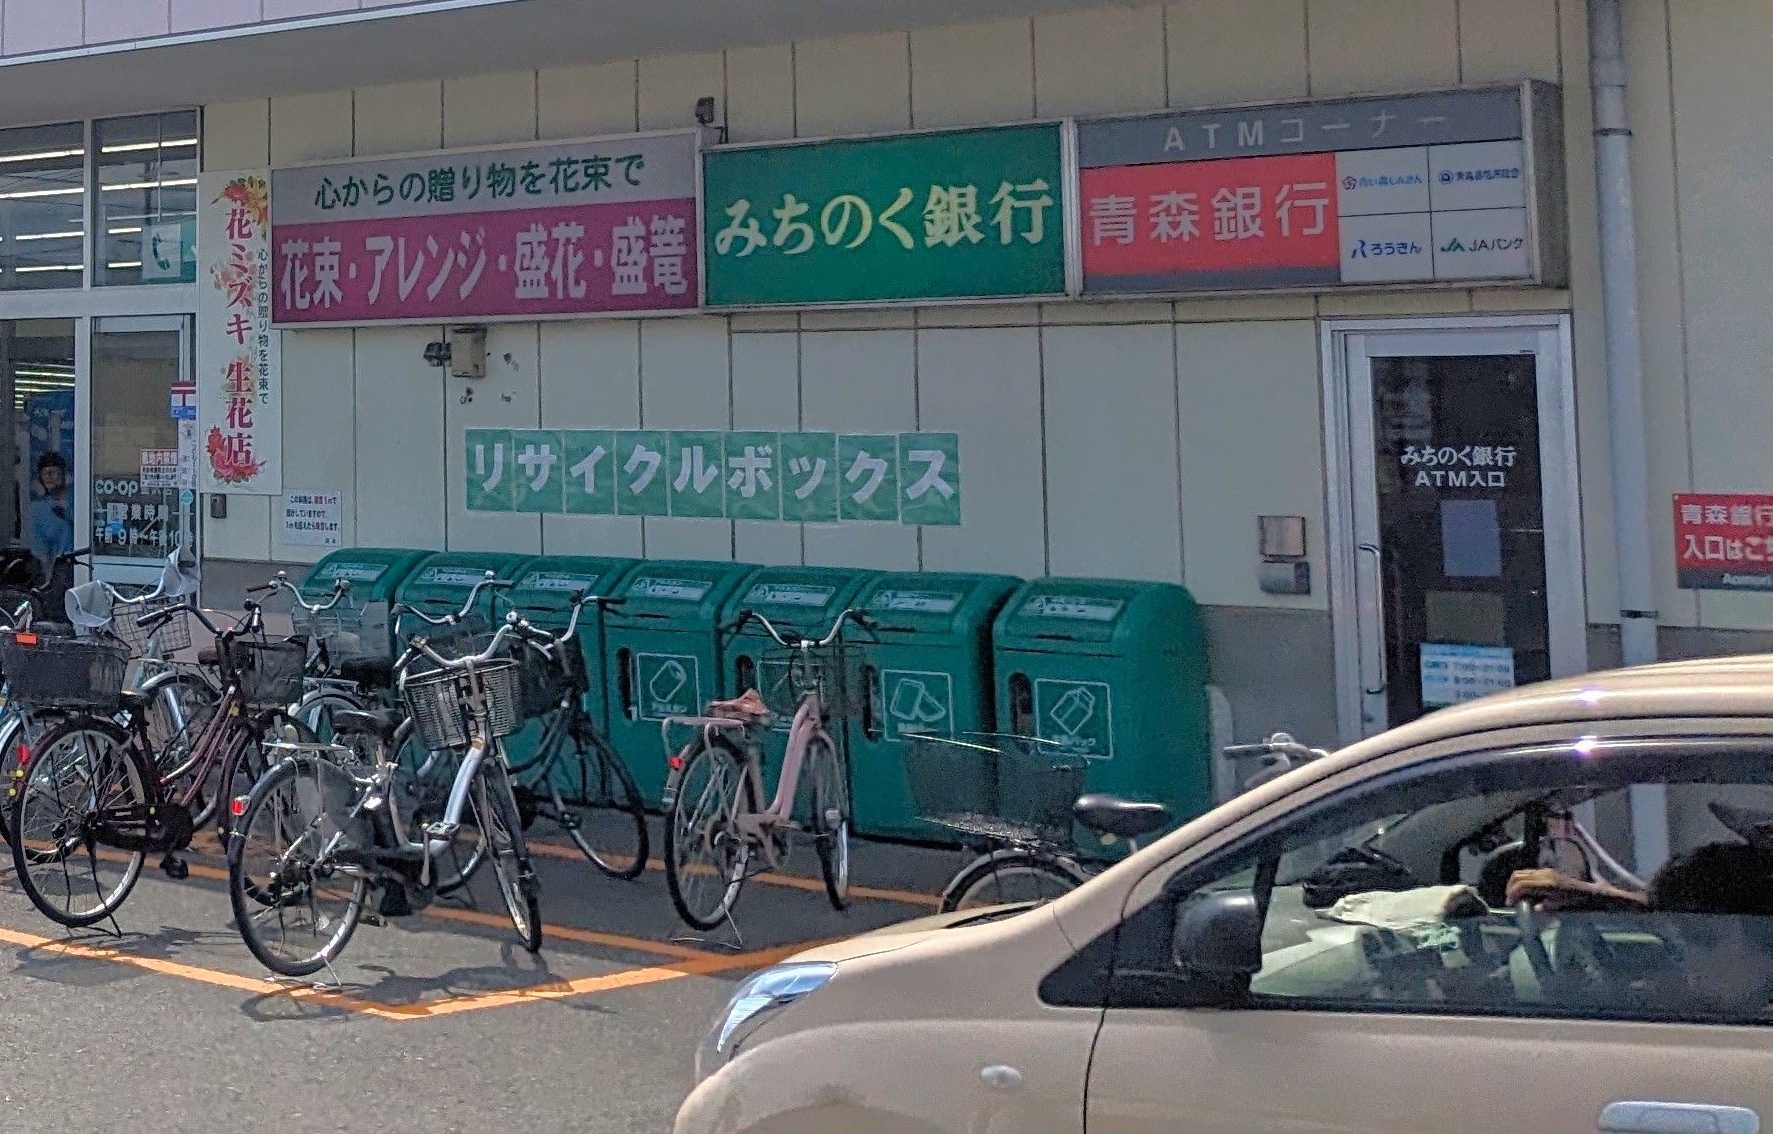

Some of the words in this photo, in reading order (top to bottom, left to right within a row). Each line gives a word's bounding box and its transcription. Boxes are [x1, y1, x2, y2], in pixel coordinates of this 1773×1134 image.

[314, 154, 645, 210] 心からの贈り物を花束で
[714, 178, 1054, 257] みちのく銀行
[1088, 180, 1329, 246] 青森銀行
[225, 208, 253, 345] 花ミズキ
[1370, 241, 1423, 256] ろうきん
[225, 361, 254, 466] 生花店
[474, 444, 956, 504] リサイクルボックス
[1400, 445, 1517, 467] みちのく銀行
[1414, 470, 1506, 488] ATM入口
